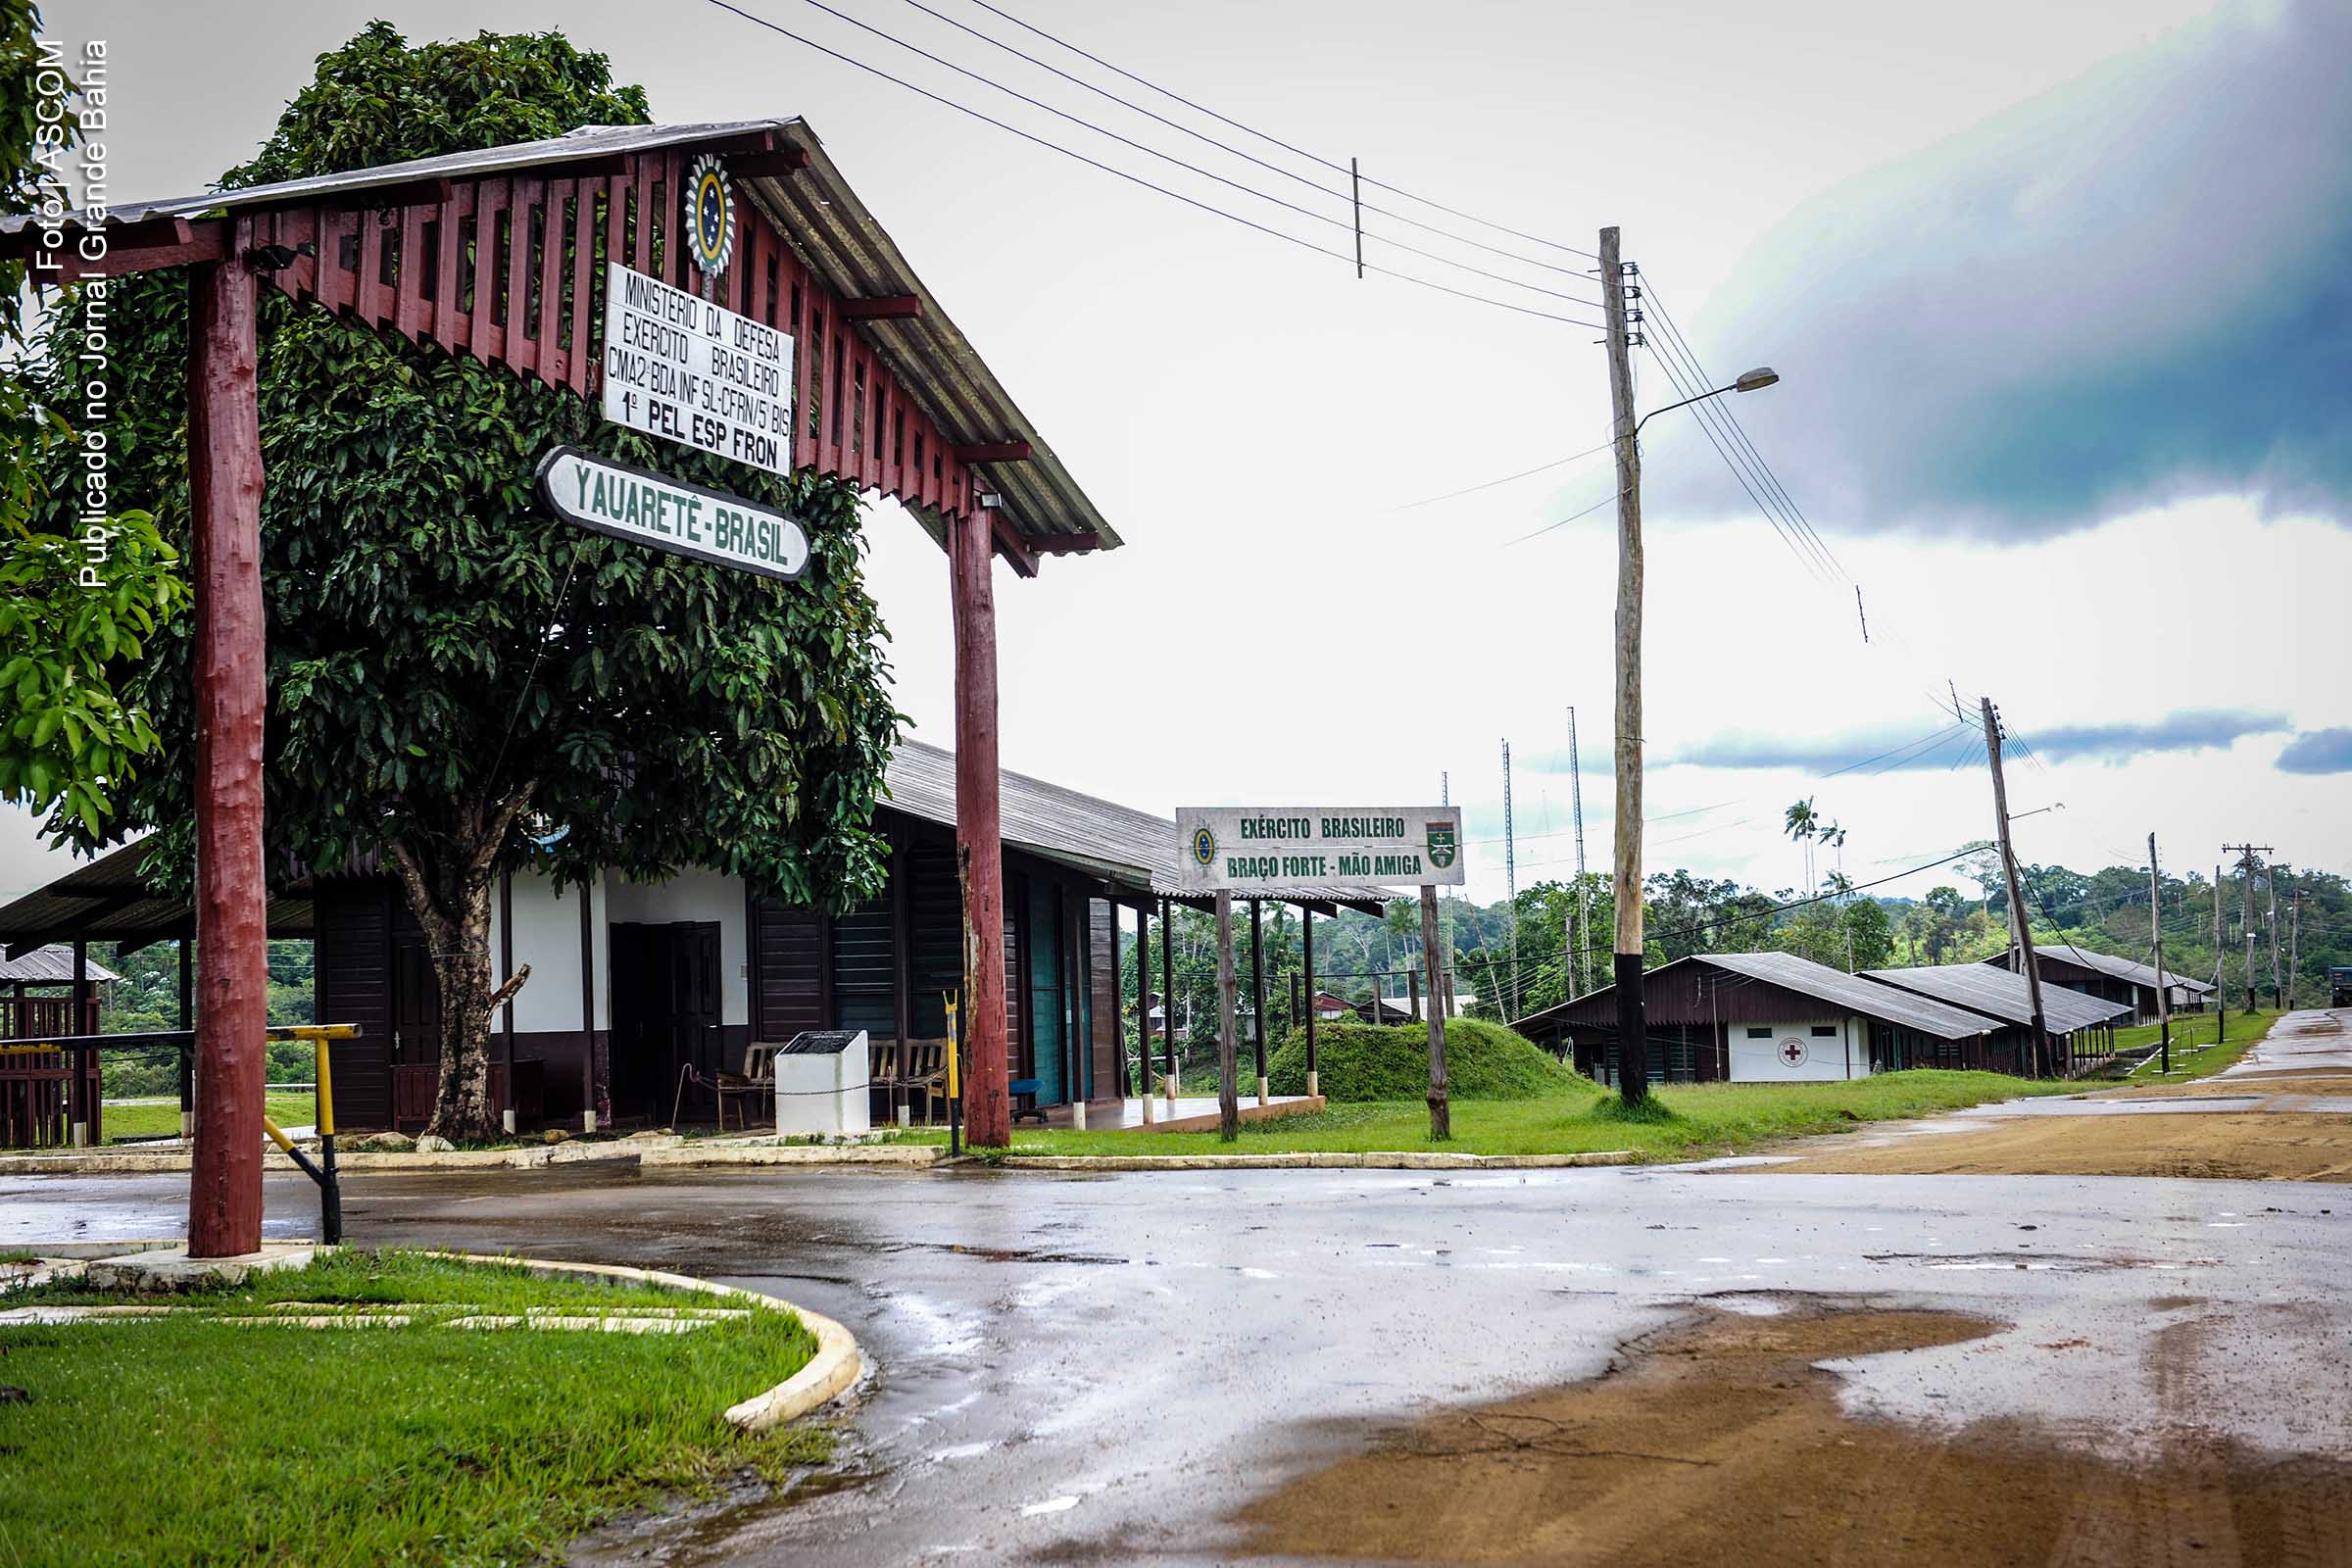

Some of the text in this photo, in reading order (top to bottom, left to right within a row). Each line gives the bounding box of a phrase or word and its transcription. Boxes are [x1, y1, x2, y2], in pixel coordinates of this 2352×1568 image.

[623, 312, 779, 398] EXERCITO BRASILEIRO
[706, 307, 722, 340] DA
[734, 318, 781, 364] DEFESA
[649, 398, 685, 440] PEL
[692, 414, 727, 451] ESP
[733, 427, 777, 468] FRON
[679, 370, 700, 405] INF
[772, 404, 790, 437] BIS
[1240, 815, 1405, 840] EXÉRCITO BRASILEIRO
[1227, 856, 1279, 881] BRAÇO
[1282, 856, 1327, 878] FORTE
[1339, 852, 1371, 876] MÃO
[1374, 855, 1422, 876] AMIGA
